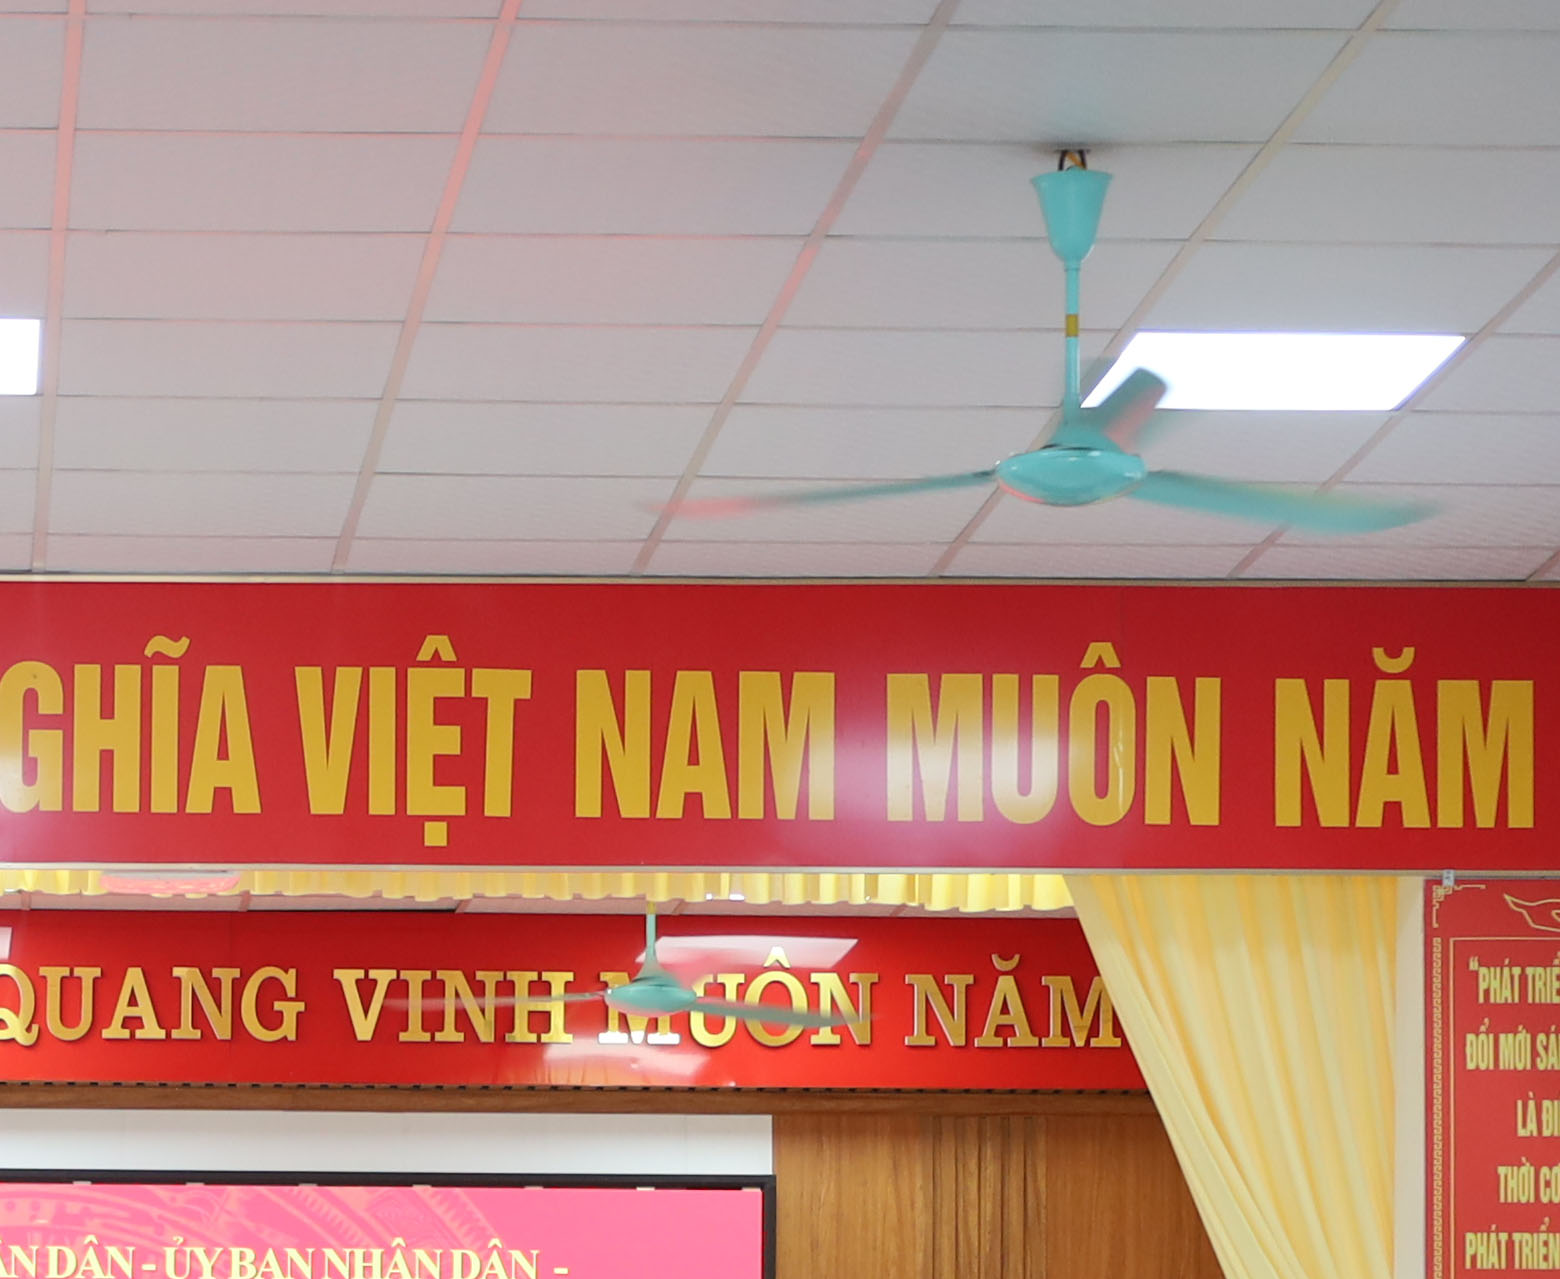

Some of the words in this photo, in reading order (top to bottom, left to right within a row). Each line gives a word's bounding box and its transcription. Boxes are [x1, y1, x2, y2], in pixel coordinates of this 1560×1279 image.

[294, 635, 532, 847] VIỆT
[575, 669, 835, 821] NAM
[886, 642, 1221, 826] MUÔN
[1275, 647, 1534, 828] NĂM
[333, 968, 574, 1044] VINH
[904, 953, 1122, 1048] NĂM
[1469, 957, 1521, 1003] “PHÁT
[1517, 1092, 1538, 1137] LÀ
[46, 1235, 135, 1279] DÂN
[164, 1236, 223, 1279] ỦY
[229, 1247, 314, 1279] BAN
